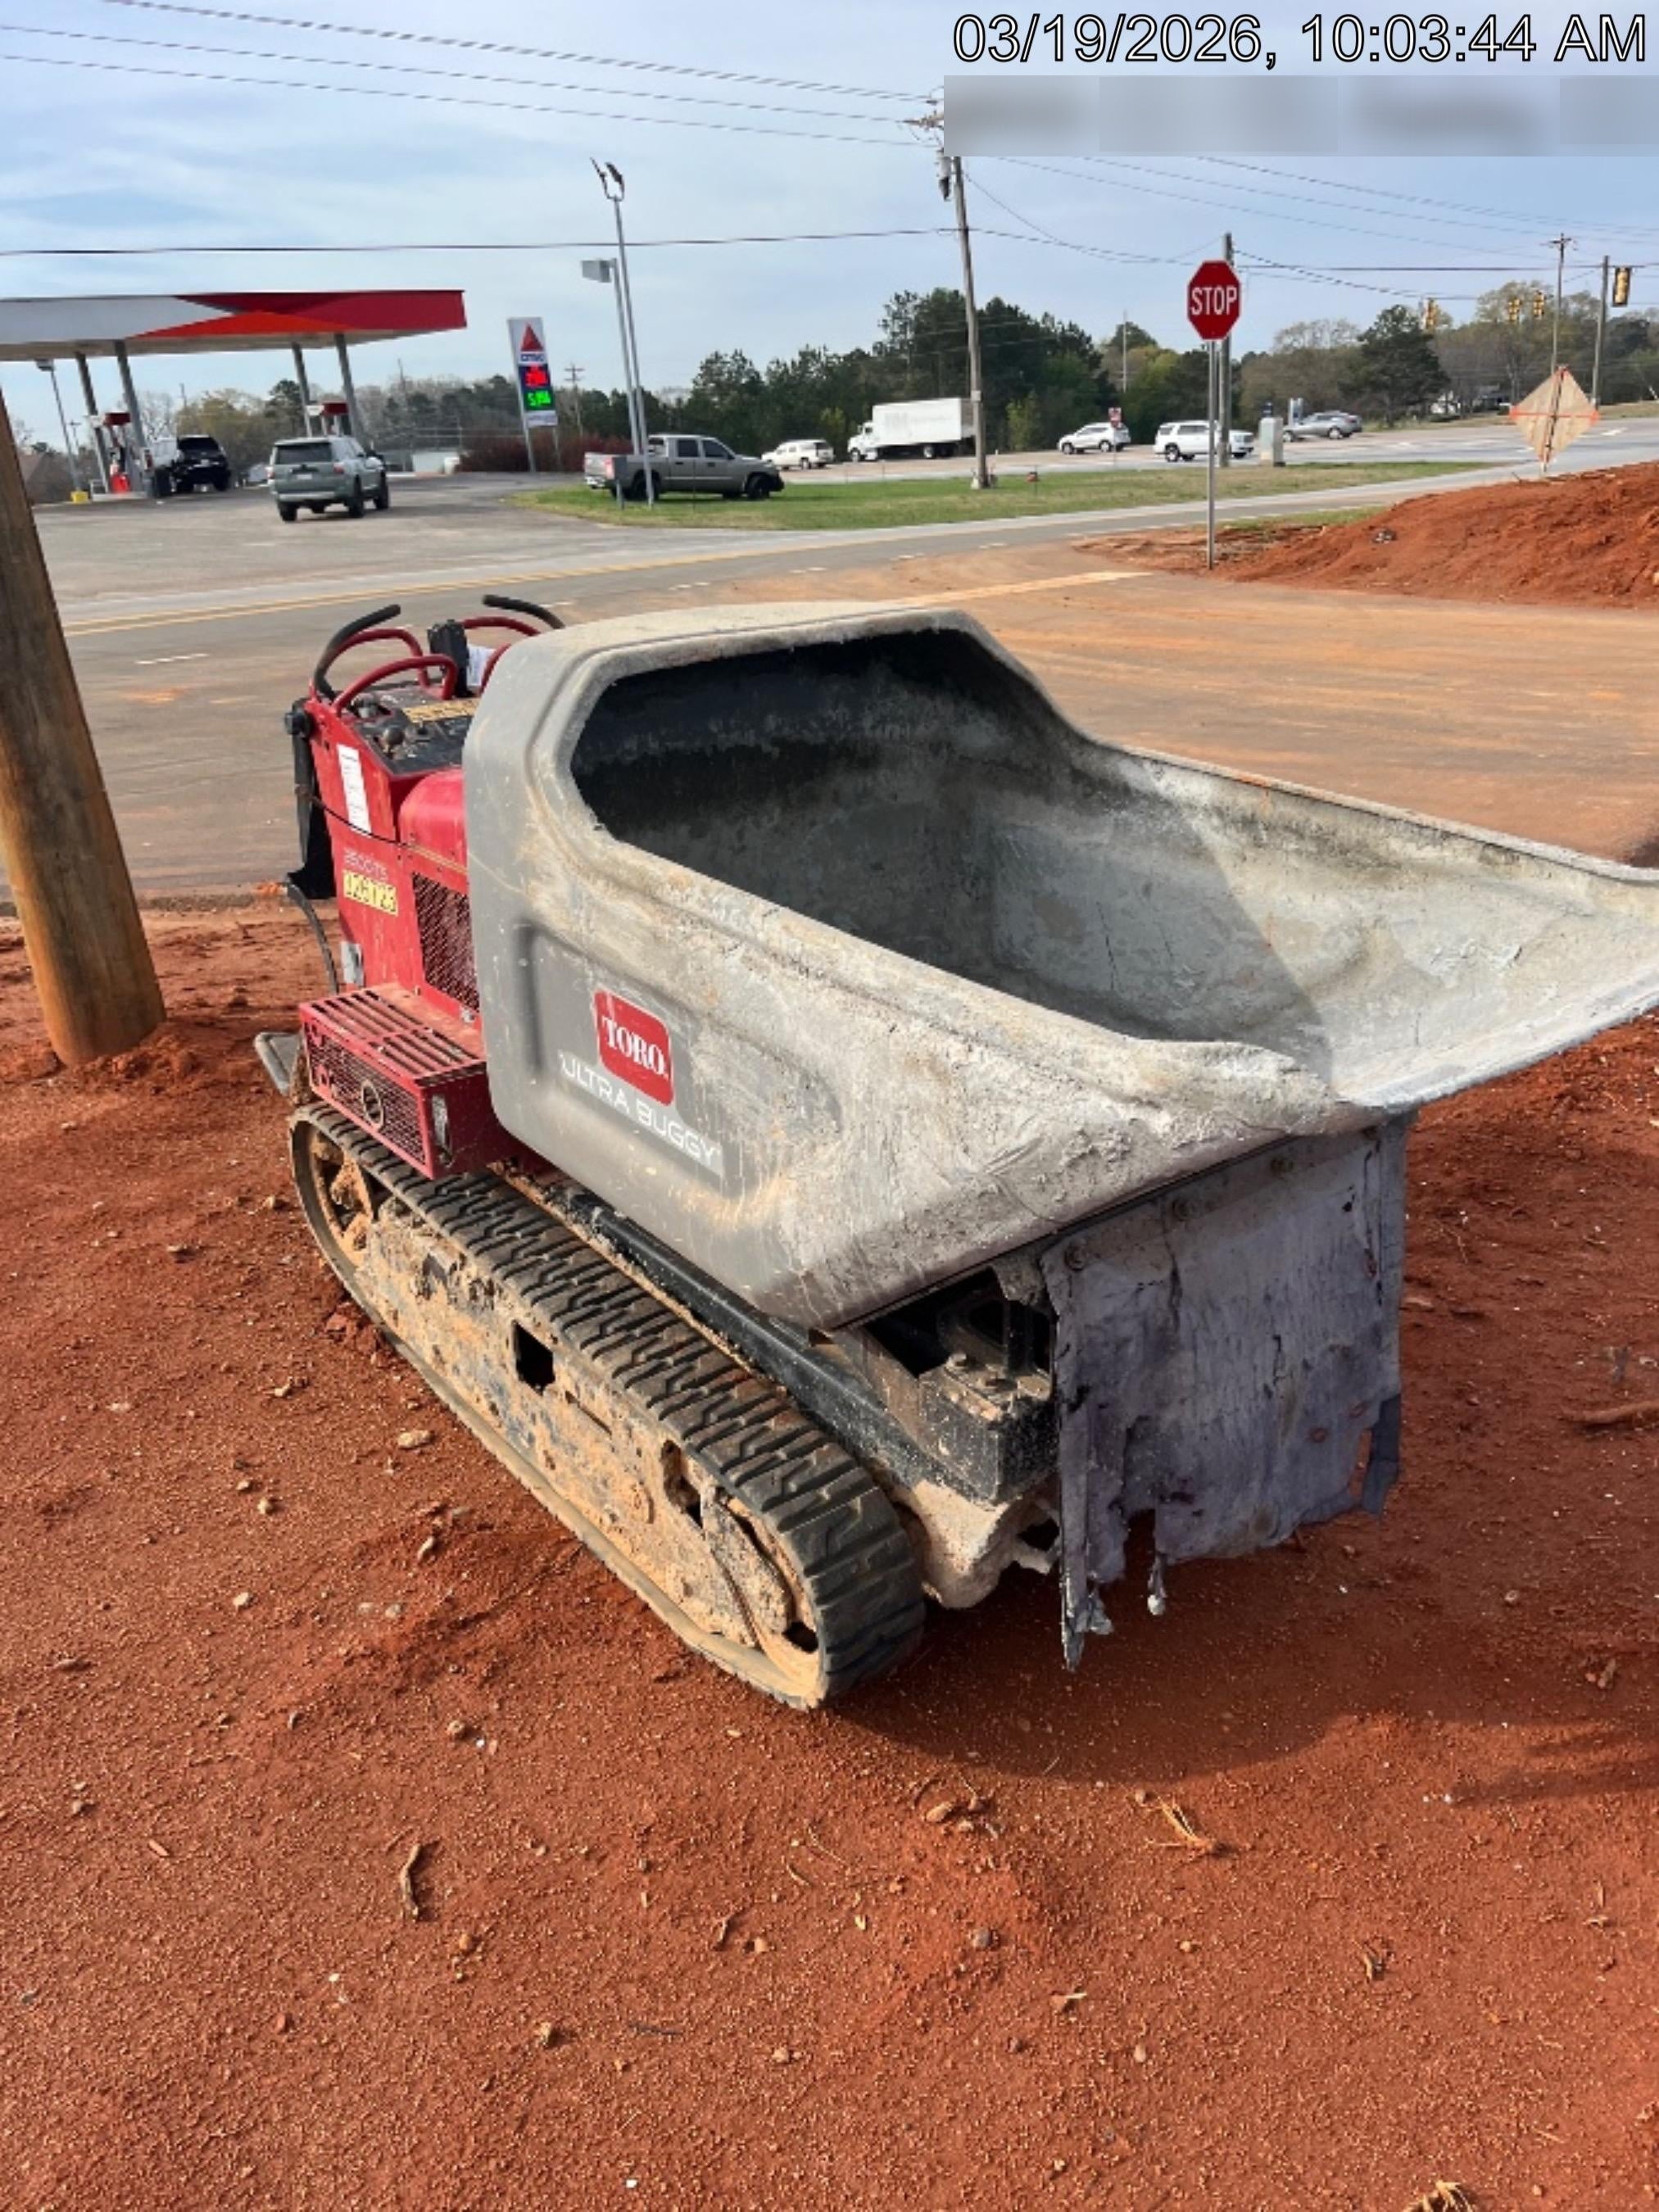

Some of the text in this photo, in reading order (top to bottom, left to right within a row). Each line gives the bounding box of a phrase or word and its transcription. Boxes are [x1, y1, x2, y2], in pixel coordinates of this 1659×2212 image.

[1191, 286, 1237, 315] STOP
[601, 1014, 666, 1076] TORO
[560, 1052, 718, 1167] ULTRA BUGGY
